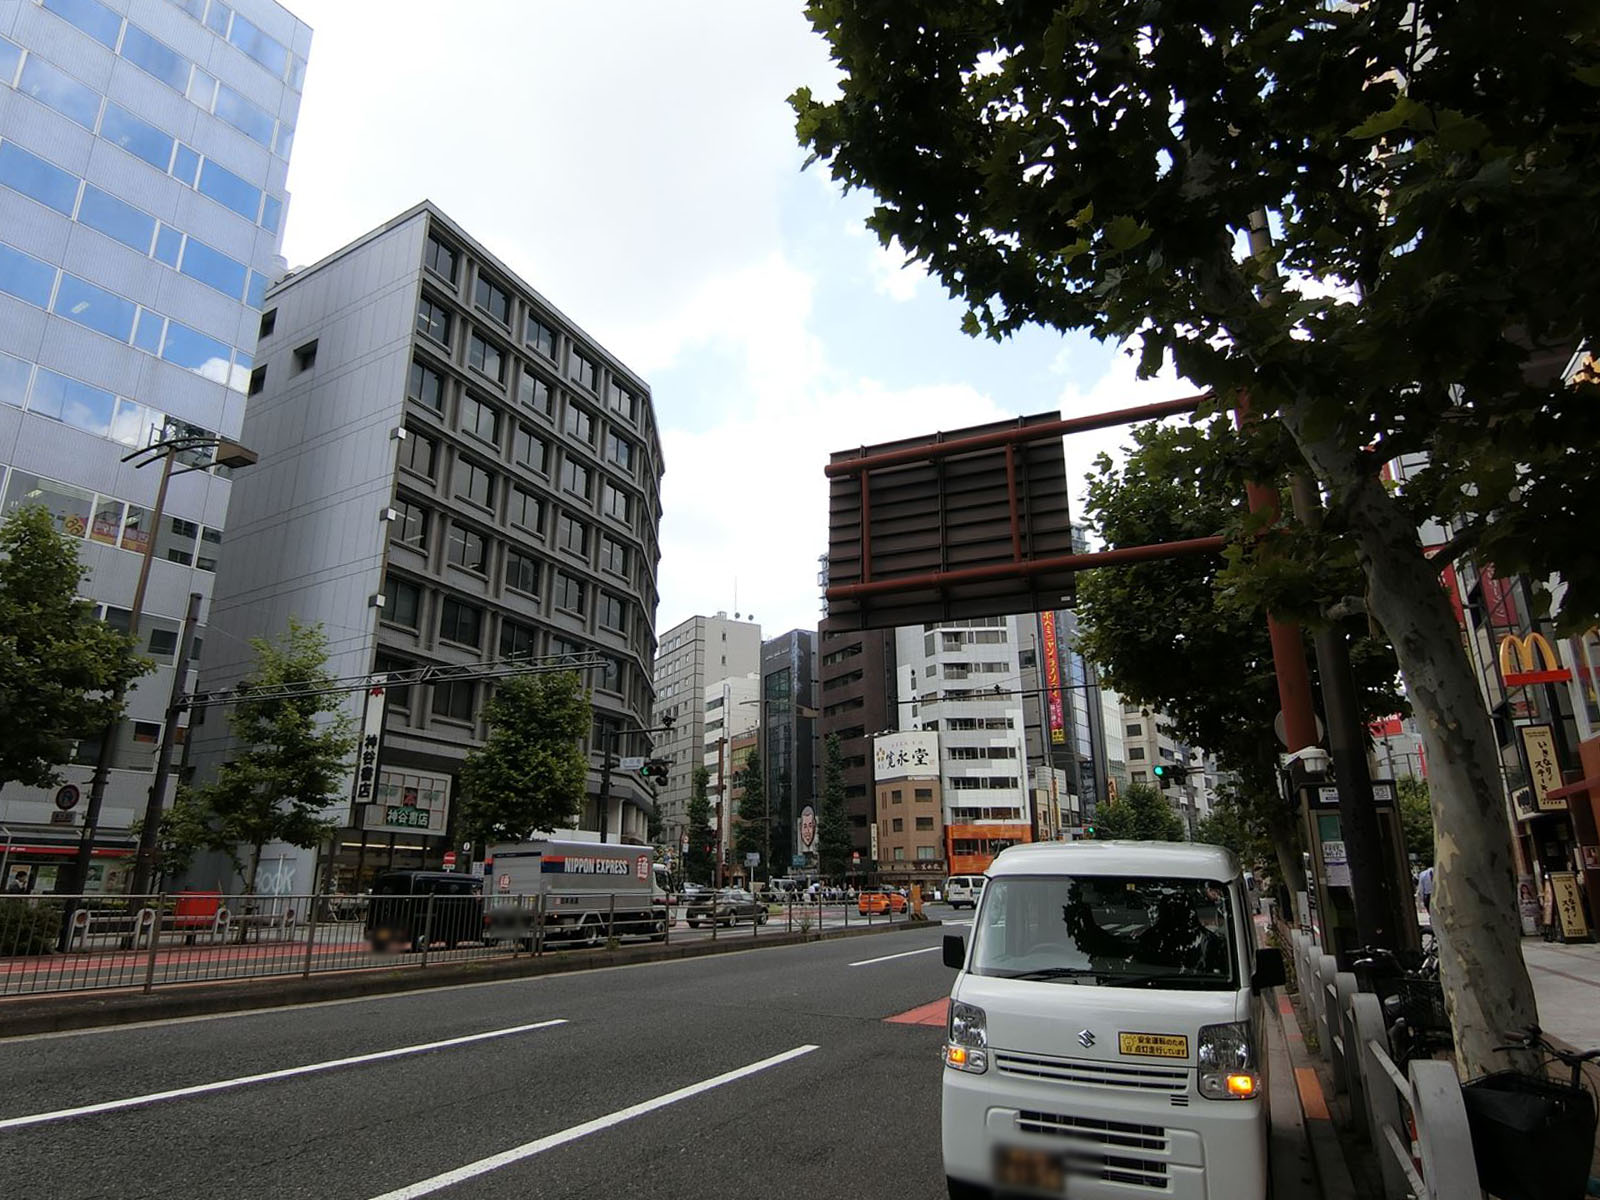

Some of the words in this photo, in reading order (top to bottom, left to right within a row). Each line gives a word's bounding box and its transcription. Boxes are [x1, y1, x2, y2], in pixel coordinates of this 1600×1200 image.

[357, 734, 378, 799] 神谷書店
[387, 808, 429, 827] 神谷書店
[564, 857, 595, 874] NIPPON
[596, 858, 628, 875] EXPRESS
